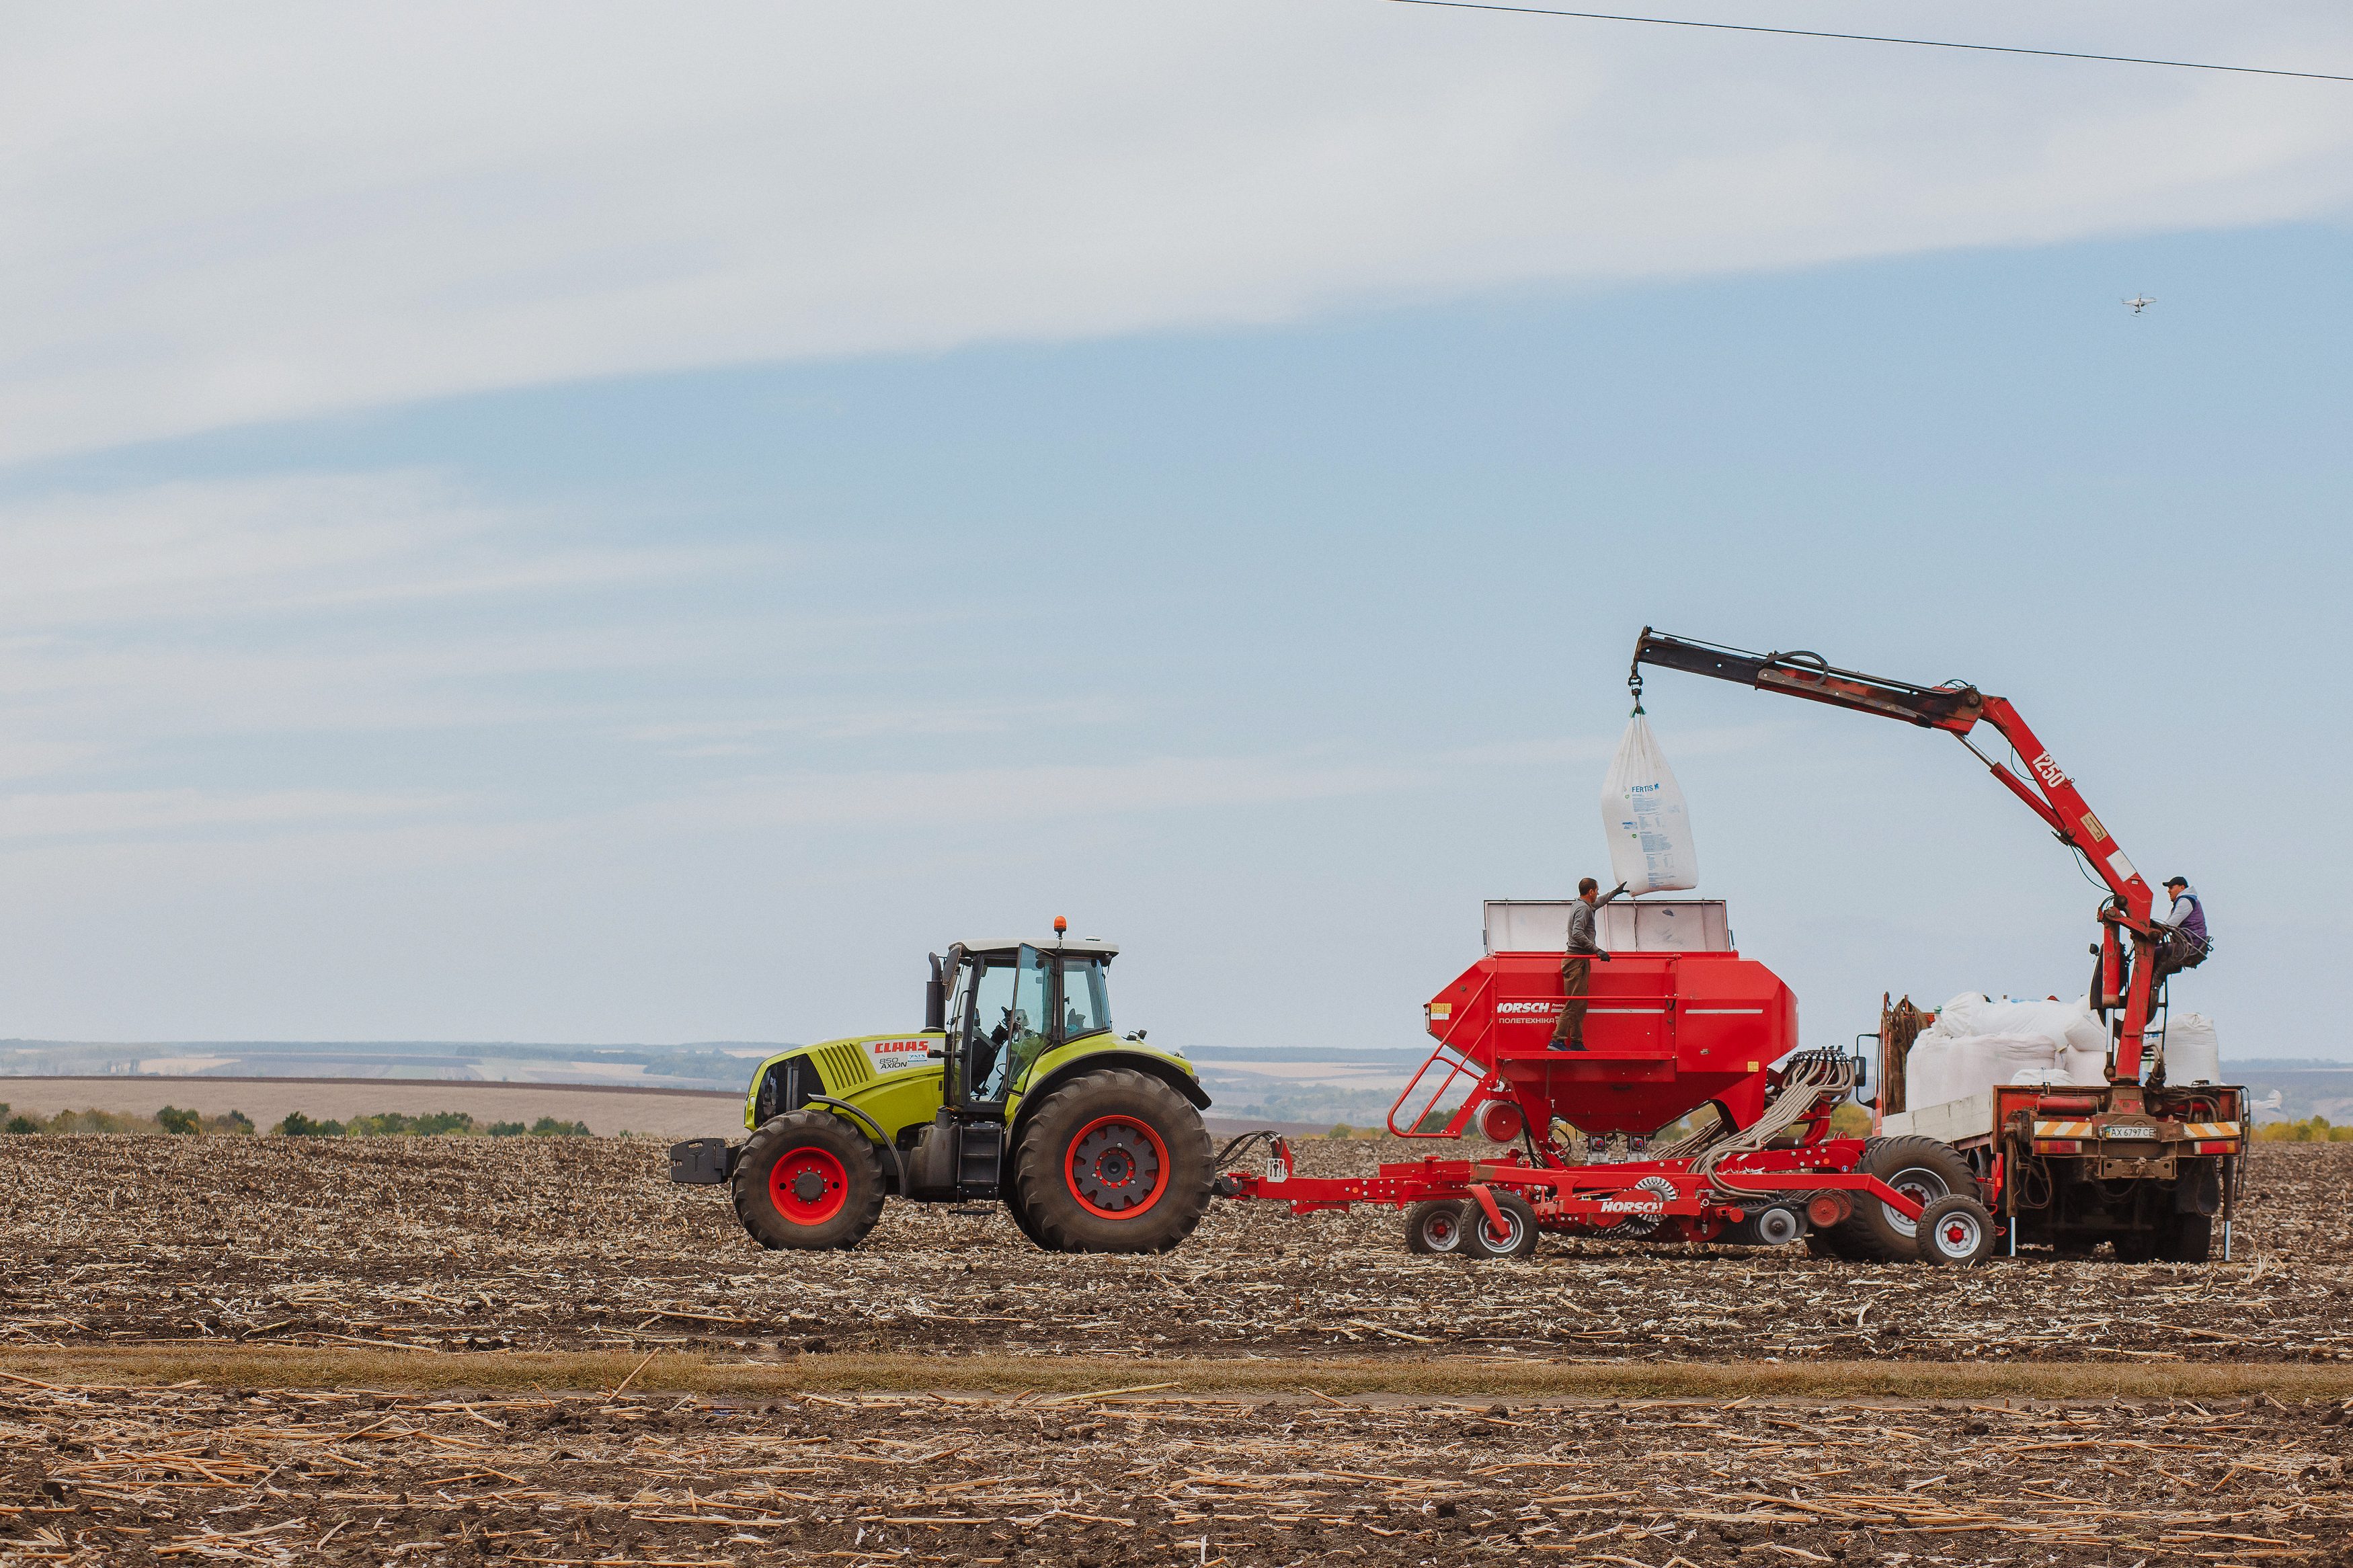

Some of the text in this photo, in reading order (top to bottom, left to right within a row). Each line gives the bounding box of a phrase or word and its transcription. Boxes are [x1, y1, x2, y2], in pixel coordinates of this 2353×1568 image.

[2032, 751, 2066, 788] 1250
[875, 1041, 928, 1053] CLAAS
[1601, 1201, 1664, 1212] HORSCH
